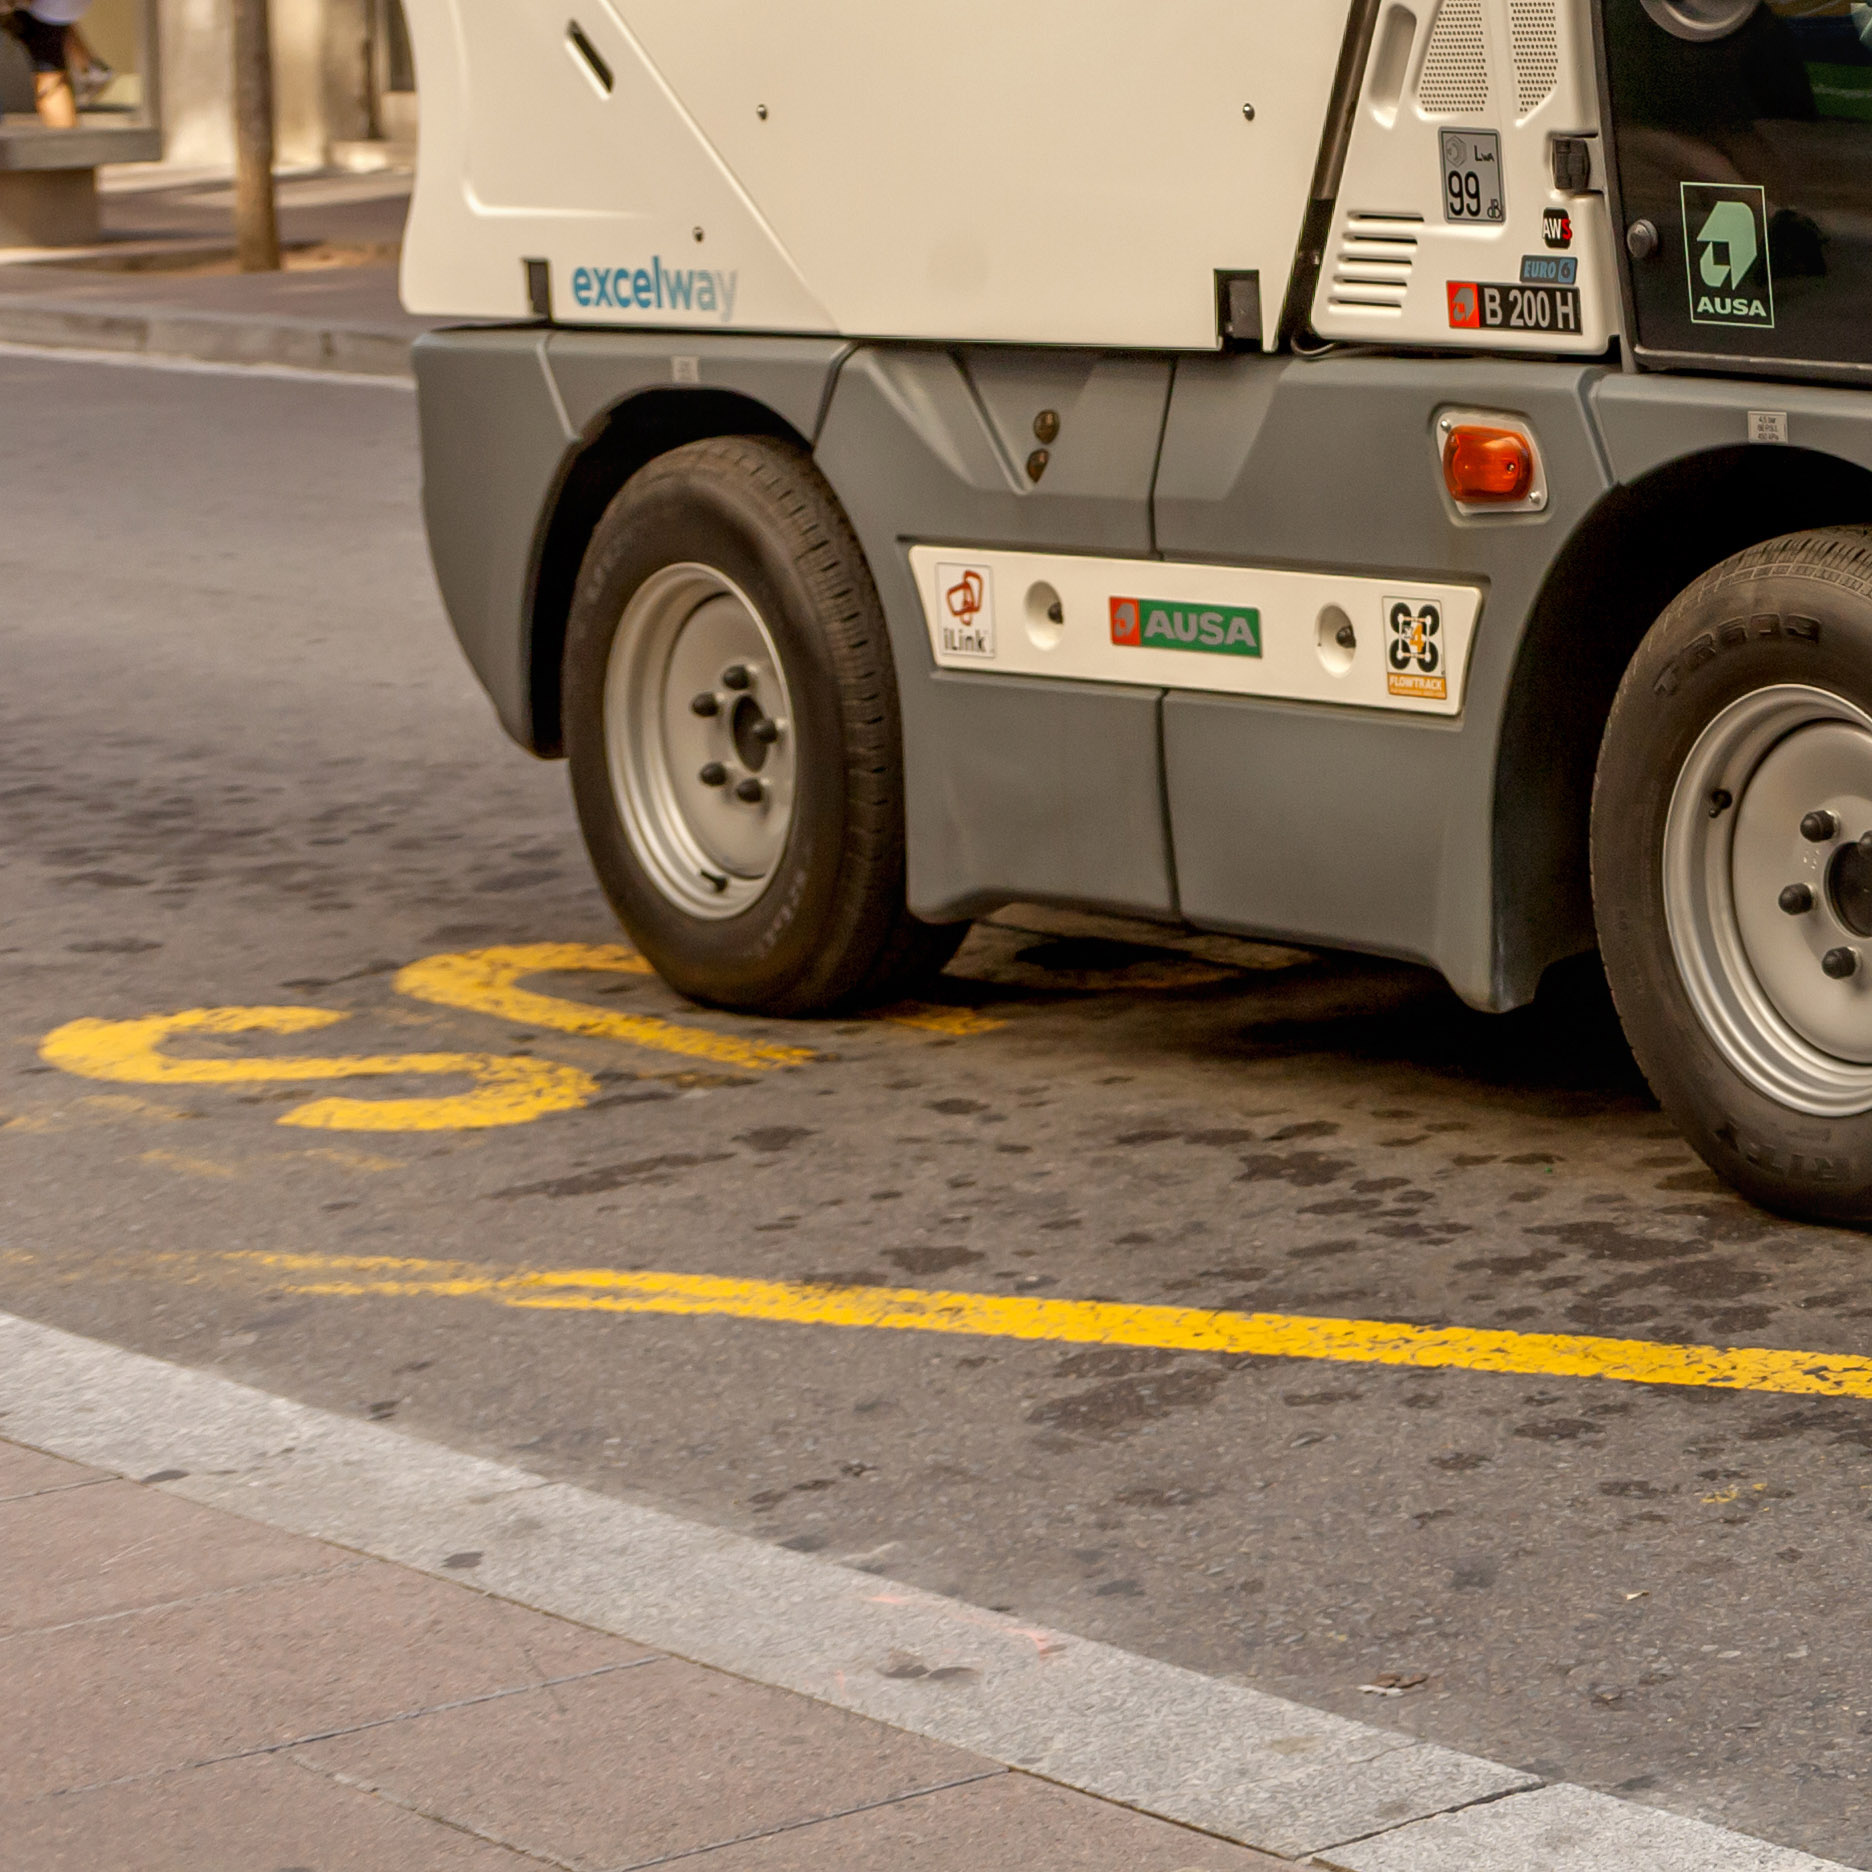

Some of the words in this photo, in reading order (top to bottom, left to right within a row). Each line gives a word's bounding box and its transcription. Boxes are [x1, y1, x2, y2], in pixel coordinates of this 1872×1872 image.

[1448, 170, 1481, 217] 99
[1542, 218, 1572, 240] AWS
[1523, 260, 1557, 278] EURO
[573, 256, 737, 322] excelway
[1697, 296, 1767, 317] AUSA
[1483, 287, 1503, 325] B
[1508, 289, 1550, 328] 200
[1556, 291, 1575, 330] H
[1143, 609, 1257, 647] AUSA
